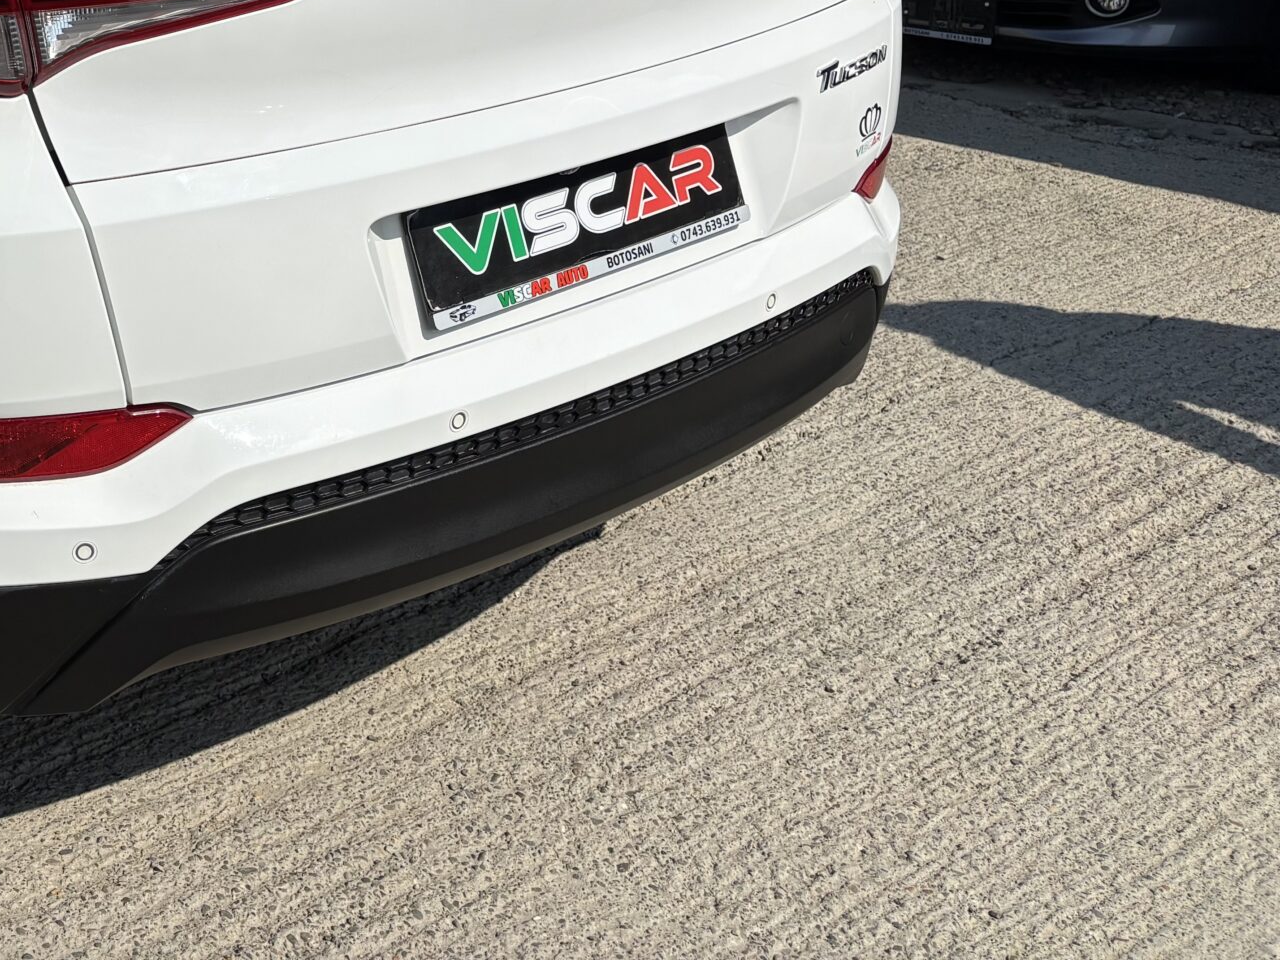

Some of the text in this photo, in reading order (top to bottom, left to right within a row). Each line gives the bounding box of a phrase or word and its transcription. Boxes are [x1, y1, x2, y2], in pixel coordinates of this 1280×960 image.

[433, 144, 723, 276] VISCAR
[497, 210, 742, 308] VISCAR AUTO BOTOSANI 0743.639.931
